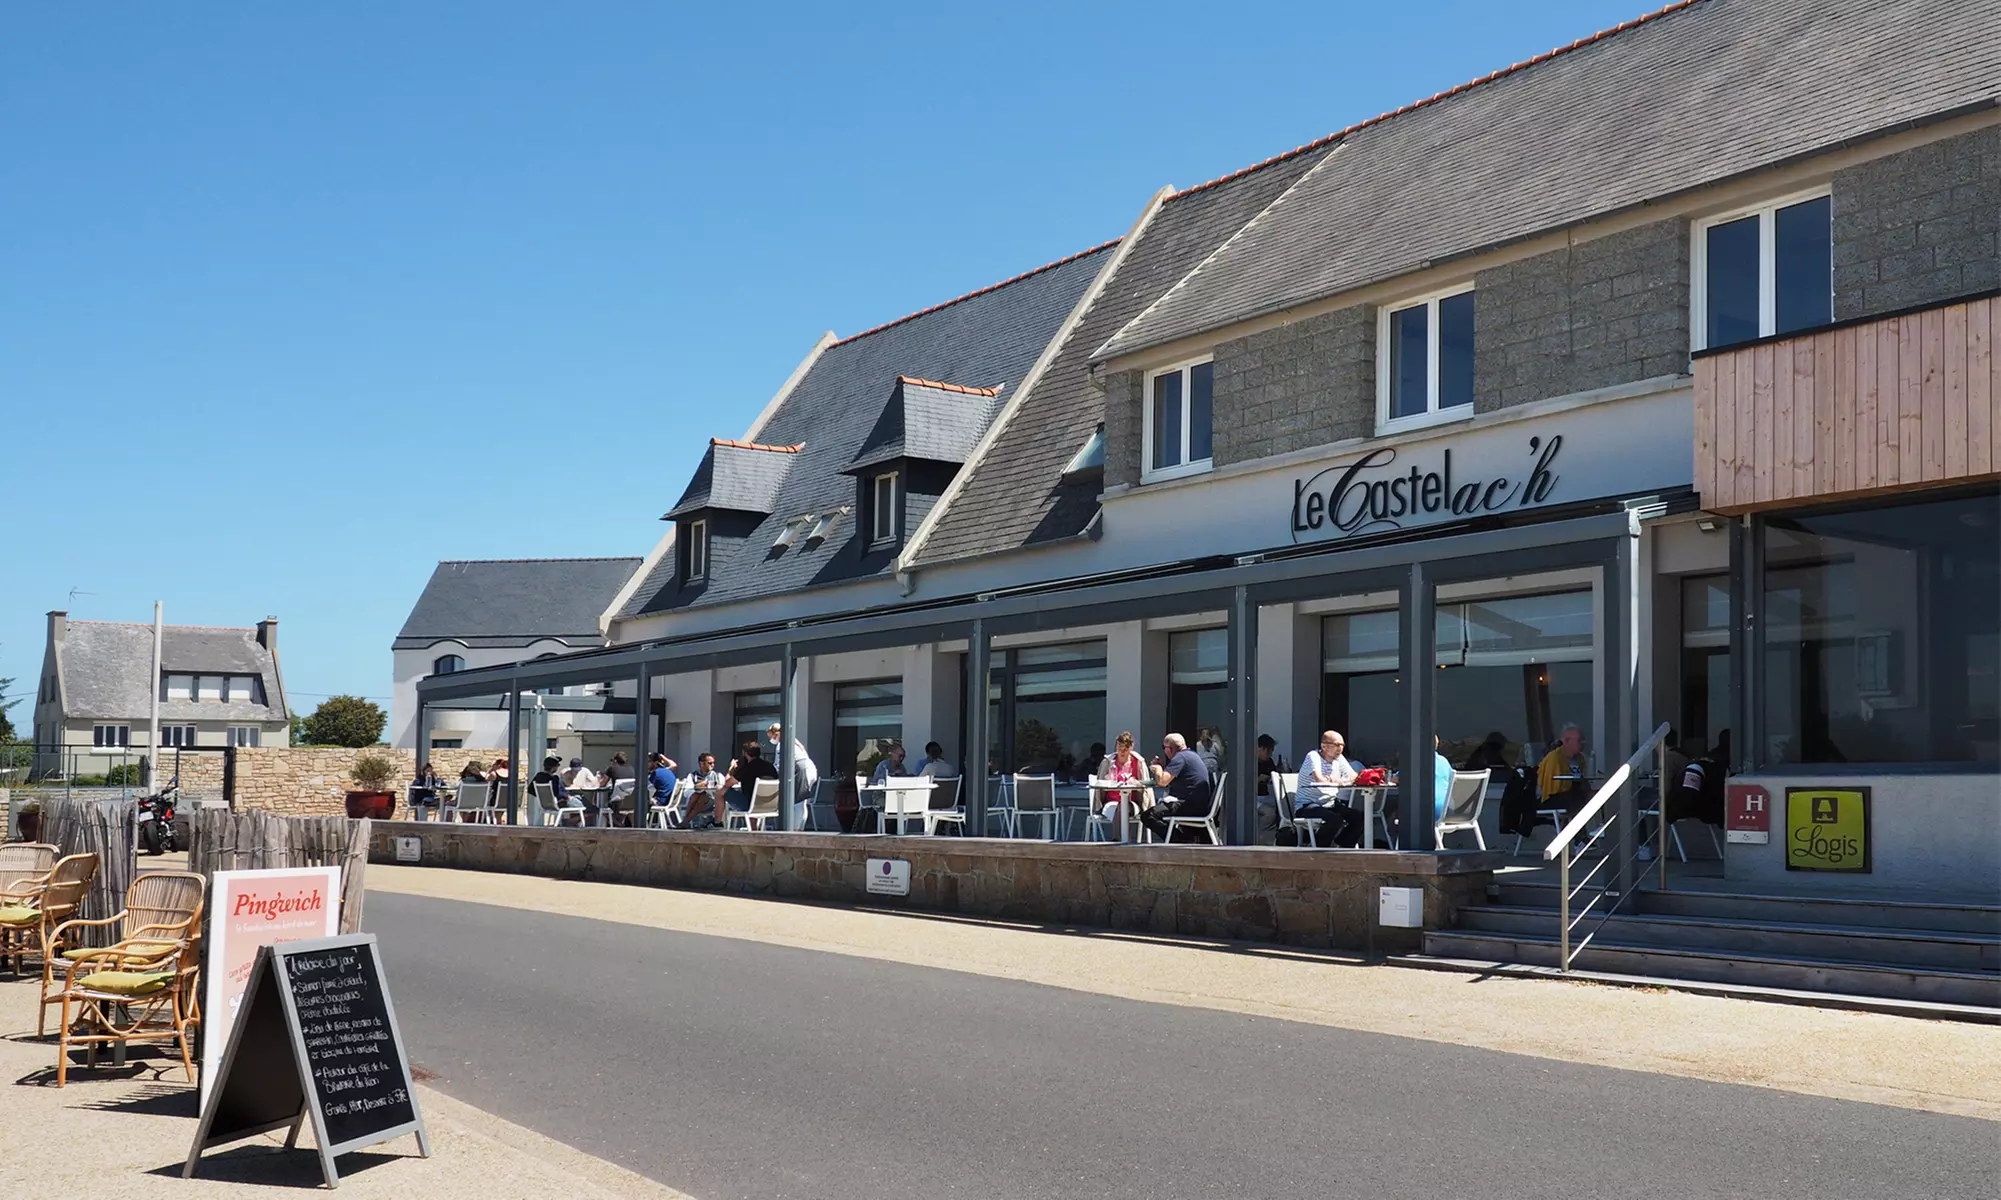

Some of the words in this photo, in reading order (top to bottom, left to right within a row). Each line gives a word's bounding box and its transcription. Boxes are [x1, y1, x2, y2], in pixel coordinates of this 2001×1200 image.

[1293, 478, 1324, 532] Le
[1746, 794, 1763, 811] H
[1792, 825, 1858, 863] Logis
[233, 889, 321, 920] Pingwich
